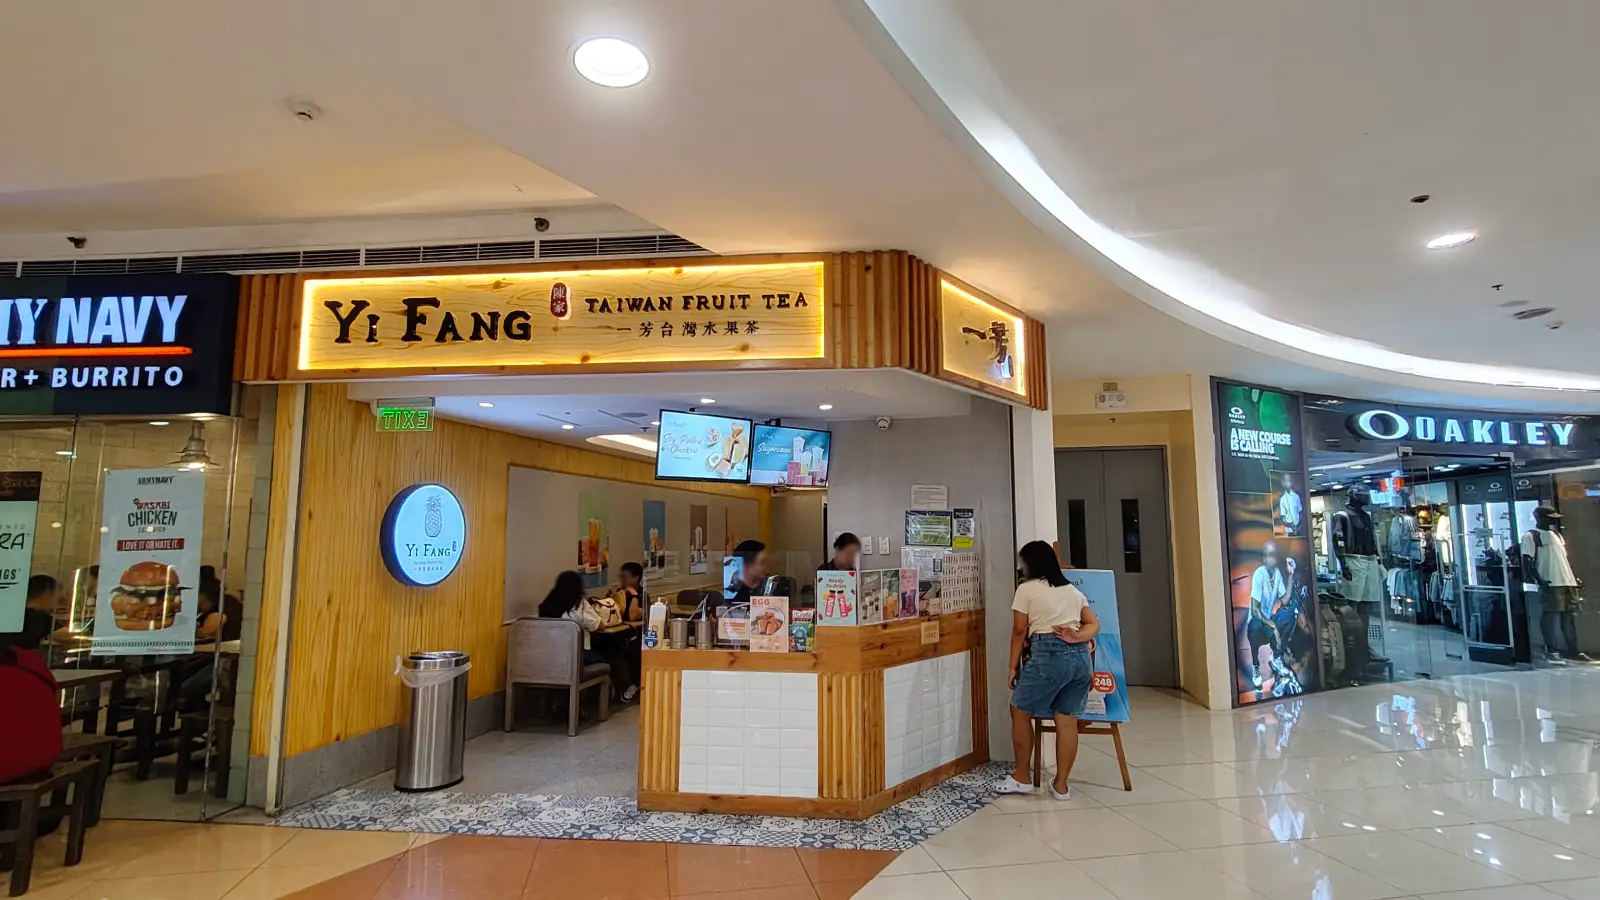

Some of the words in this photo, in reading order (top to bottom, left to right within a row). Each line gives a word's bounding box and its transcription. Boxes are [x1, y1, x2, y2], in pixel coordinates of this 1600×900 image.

[585, 297, 672, 314] TAIWAN
[682, 294, 751, 311] FRUIT
[761, 291, 809, 310] TEA
[56, 295, 188, 344] NAVY
[52, 366, 183, 388] BURRITO
[1231, 428, 1238, 440] A
[1238, 429, 1259, 442] NEW
[1259, 431, 1292, 446] COURSE
[1415, 416, 1575, 445] OAKLEY
[1231, 439, 1239, 450] IS
[1240, 440, 1275, 454] CALLING
[136, 501, 171, 511] WASABI
[127, 510, 178, 527] CHICKEN
[122, 541, 138, 550] LOVE
[139, 541, 146, 550] IT
[155, 540, 171, 549] HATE
[753, 598, 770, 606] EGG
[1094, 677, 1113, 687] 248
